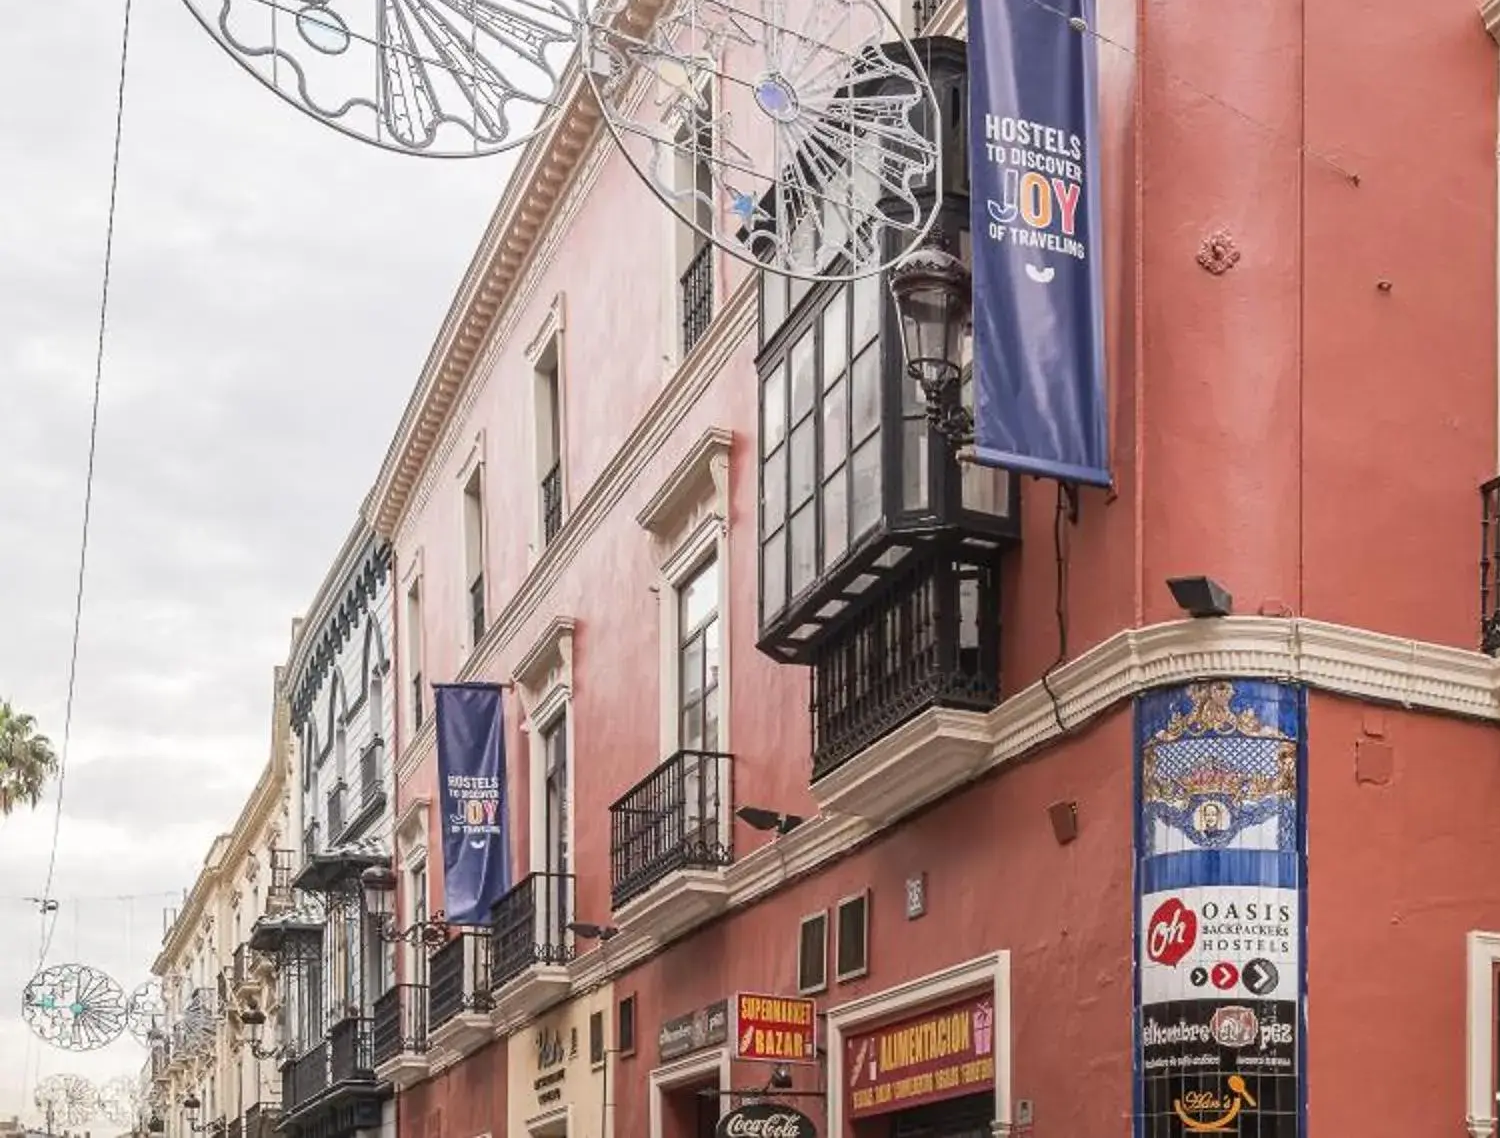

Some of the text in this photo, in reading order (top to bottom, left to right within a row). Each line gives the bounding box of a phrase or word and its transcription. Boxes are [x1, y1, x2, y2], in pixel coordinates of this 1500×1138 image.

[985, 113, 1082, 161] HOSTELS
[985, 142, 1083, 183] TO DISCOVER
[987, 168, 1081, 236] JOY
[989, 221, 1085, 260] OF TRAVELING
[448, 774, 499, 789] HOSTELS
[449, 799, 500, 825] JOY
[1201, 901, 1290, 923] OASIS
[1202, 923, 1290, 937] BACKPACKERS
[1202, 938, 1290, 953] HOSTELS
[755, 1028, 803, 1057] BAZAR
[879, 1010, 970, 1073] ALIMENTACION
